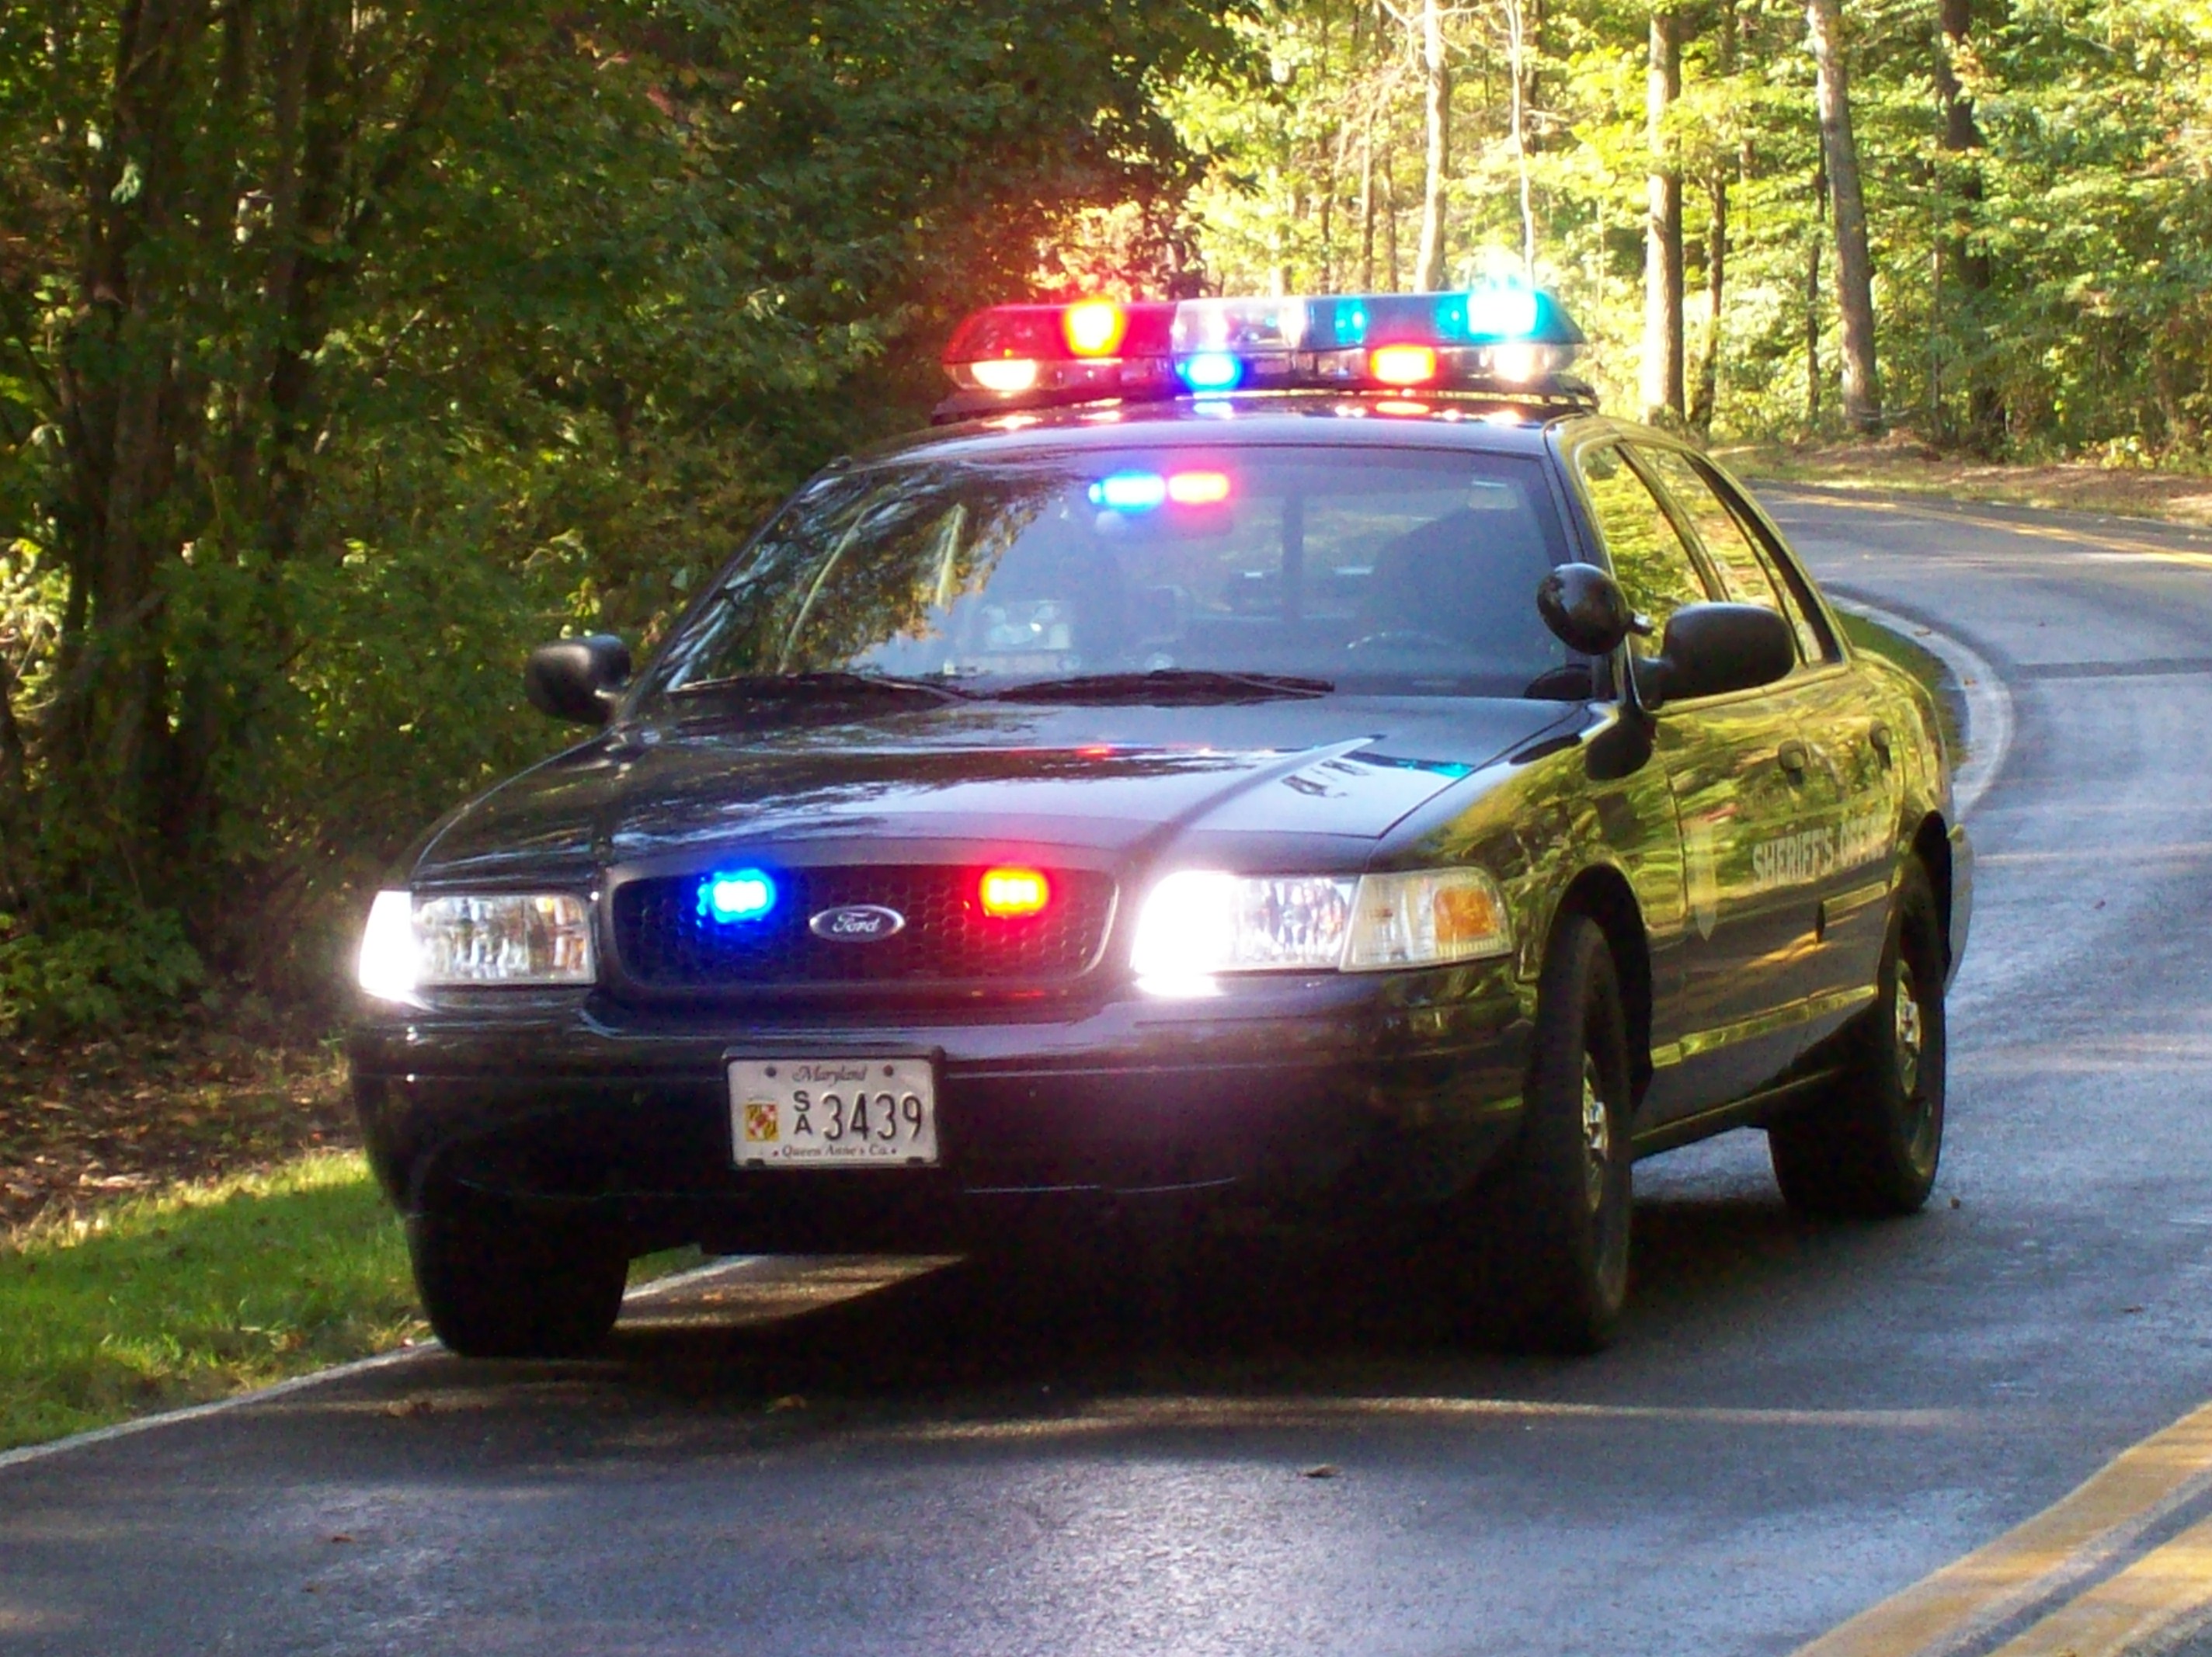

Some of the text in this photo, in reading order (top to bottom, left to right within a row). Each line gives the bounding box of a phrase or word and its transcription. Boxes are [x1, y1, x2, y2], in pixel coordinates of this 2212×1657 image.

[832, 912, 880, 933] Ford
[792, 1065, 868, 1087] Maryland
[821, 1092, 923, 1141] 3439
[782, 1144, 821, 1157] Queen
